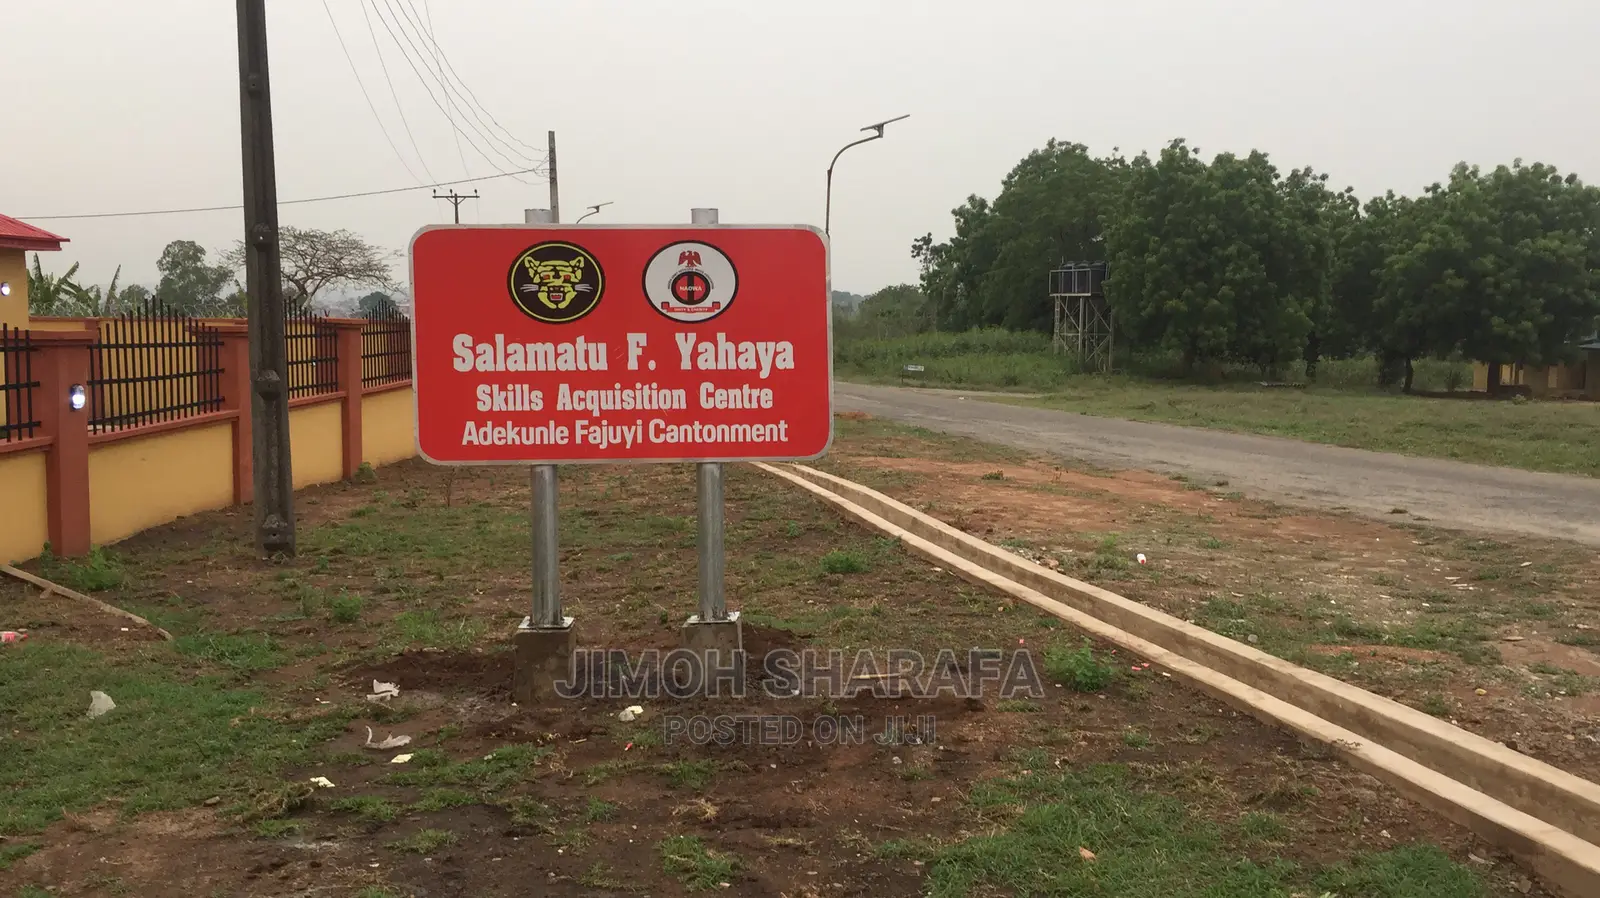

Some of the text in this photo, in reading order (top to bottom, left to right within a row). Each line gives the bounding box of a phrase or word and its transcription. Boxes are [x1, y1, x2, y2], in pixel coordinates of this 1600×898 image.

[452, 332, 795, 379] Salamatu F. Yahaya
[476, 381, 773, 417] Skills Acquisition Centre
[461, 418, 789, 449] Adekunle Fajuyi Cantonment
